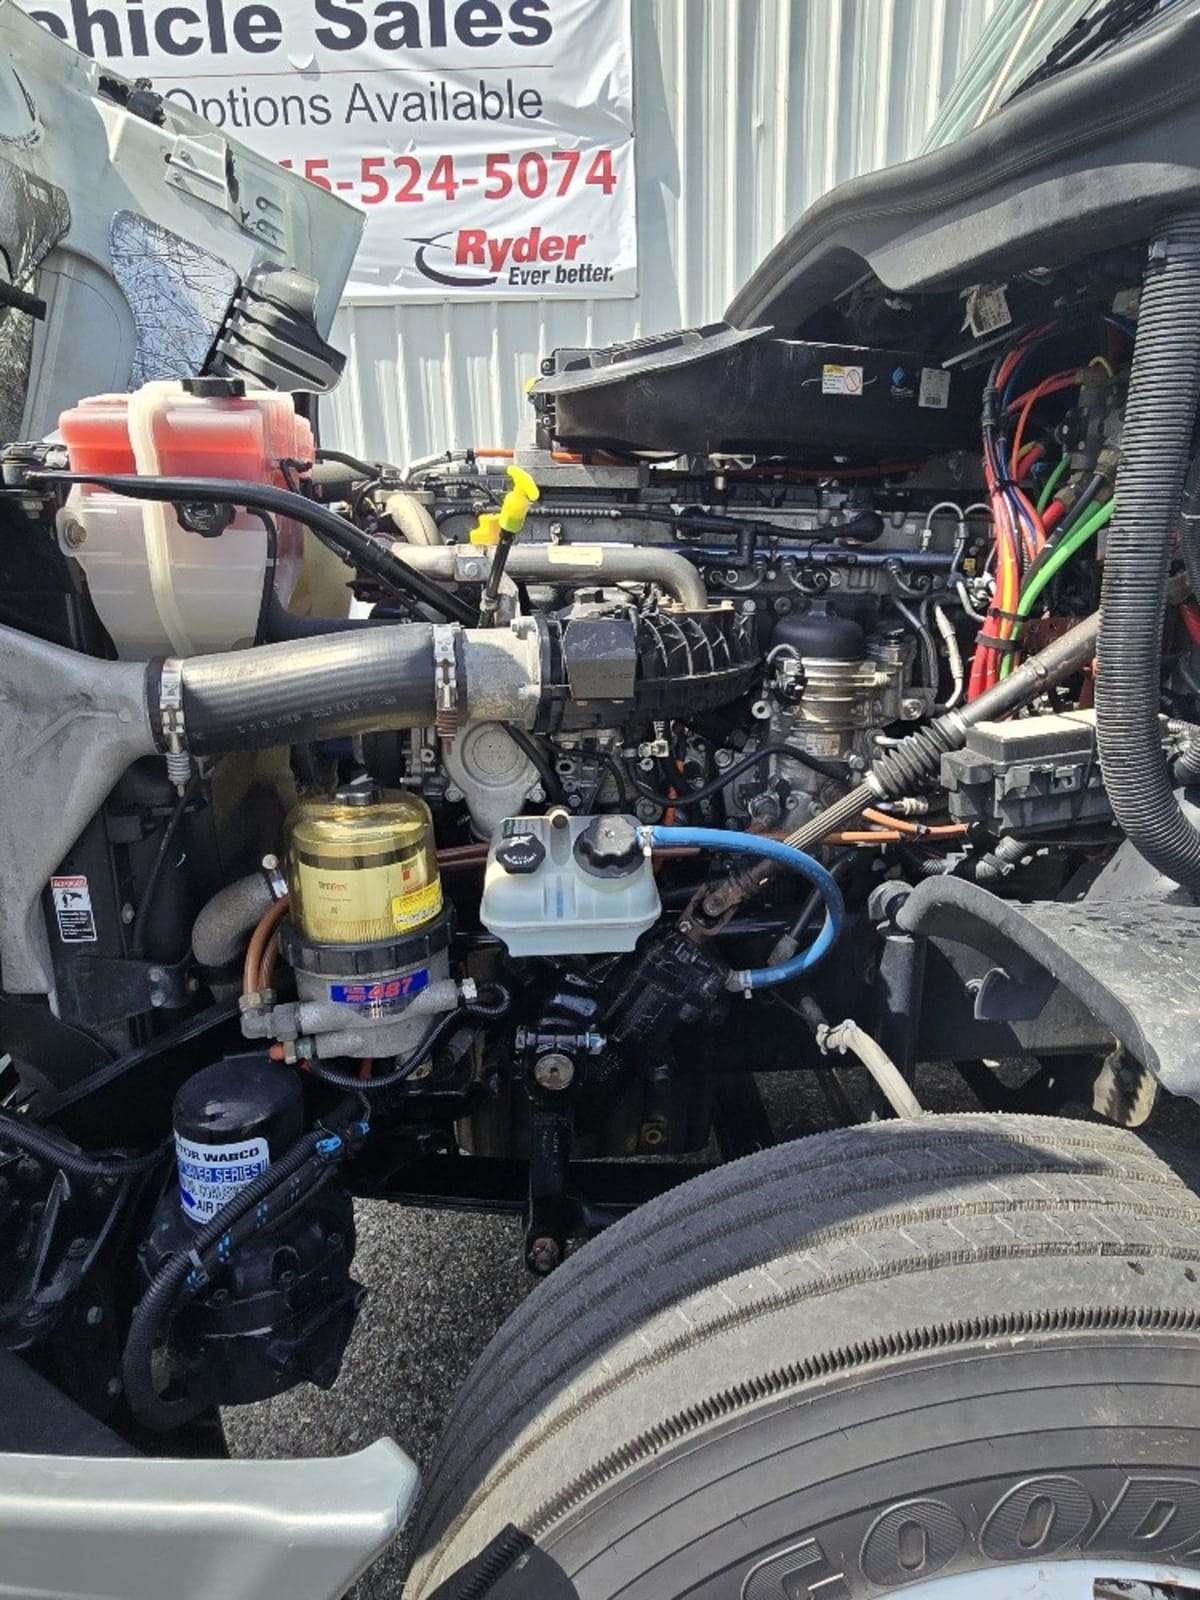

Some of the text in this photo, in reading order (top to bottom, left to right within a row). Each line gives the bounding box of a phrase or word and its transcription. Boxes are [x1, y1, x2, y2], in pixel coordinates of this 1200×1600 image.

[315, 0, 553, 51] Sales
[345, 79, 543, 124] Available
[280, 150, 617, 204] 5-524-5074
[455, 227, 586, 272] Ryder
[508, 264, 614, 286] Ever better.
[368, 976, 413, 999] 487
[203, 1147, 259, 1162] WABCO
[216, 1162, 259, 1184] SERIES
[196, 1200, 214, 1214] AIR
[739, 1473, 1200, 1600] GOOD
